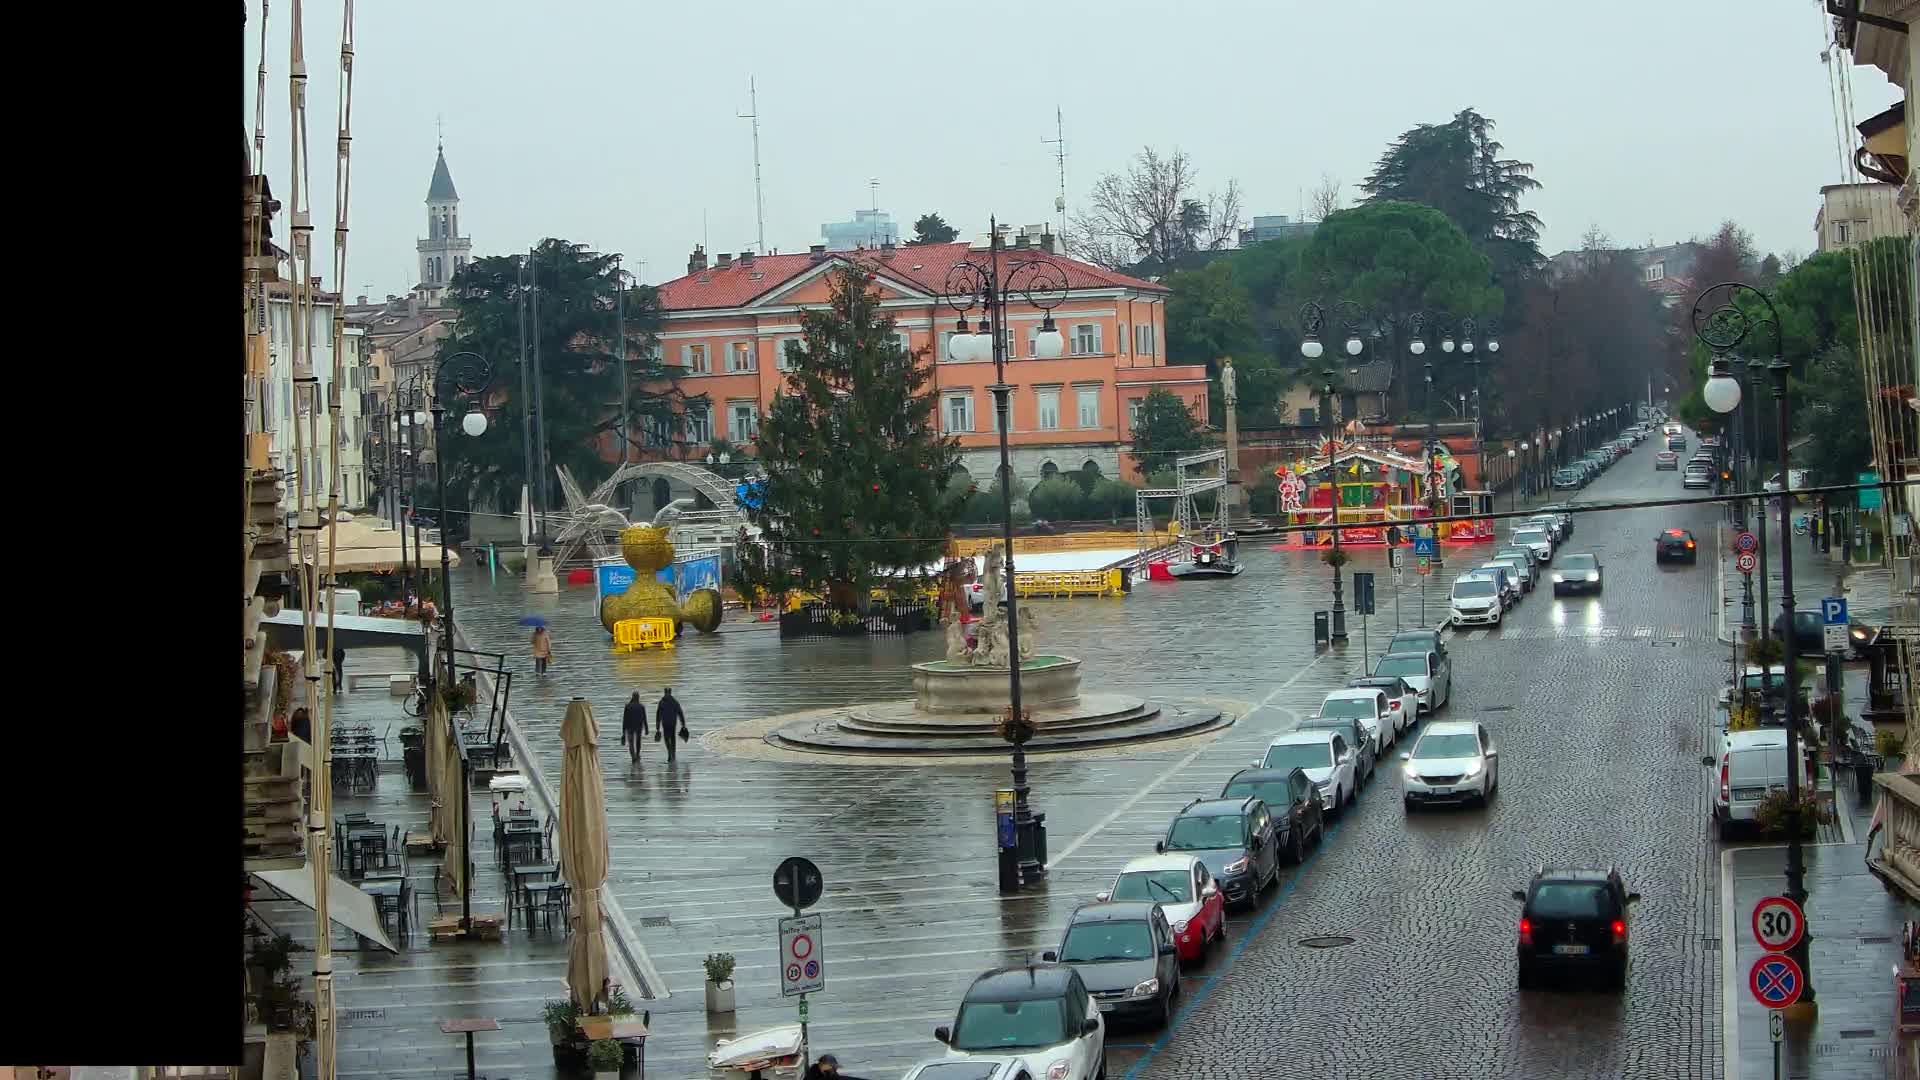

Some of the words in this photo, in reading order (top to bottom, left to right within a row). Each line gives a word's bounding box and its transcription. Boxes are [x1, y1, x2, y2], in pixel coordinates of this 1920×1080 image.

[1742, 557, 1753, 567] 20
[1827, 602, 1841, 621] P
[1762, 911, 1791, 937] 30
